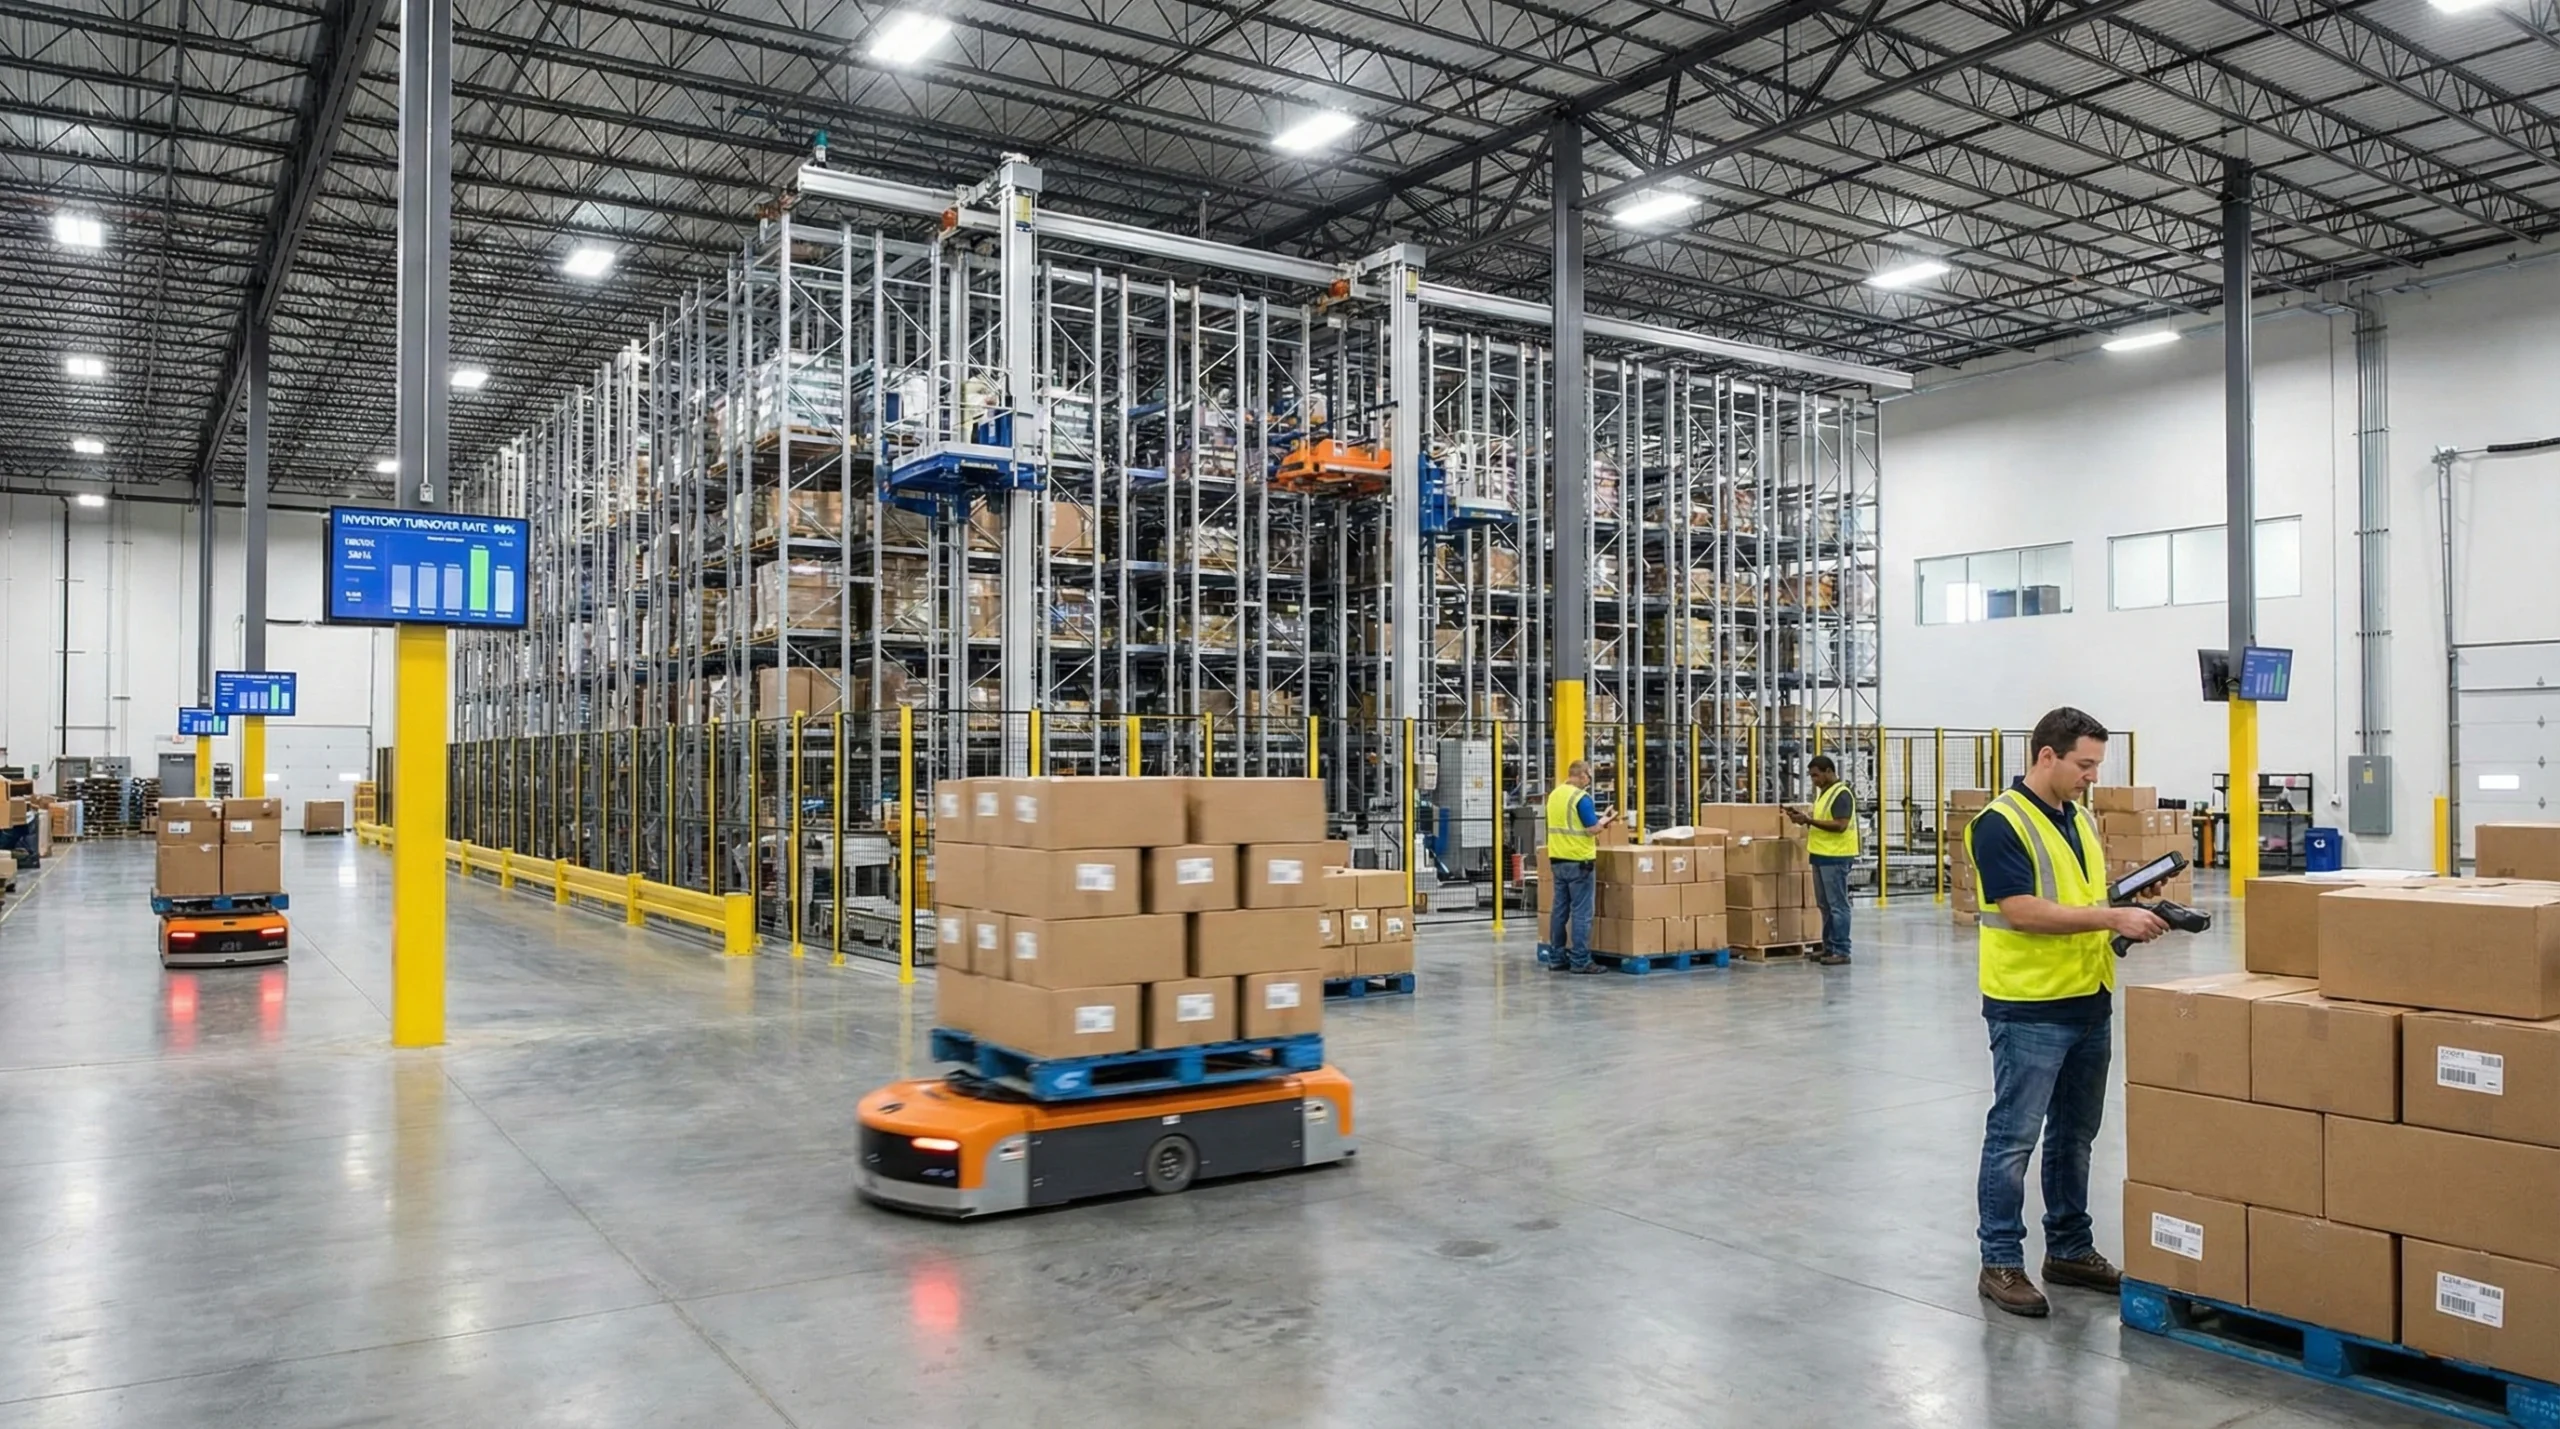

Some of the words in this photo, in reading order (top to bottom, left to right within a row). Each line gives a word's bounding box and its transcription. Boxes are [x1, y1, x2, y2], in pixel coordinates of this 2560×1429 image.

[342, 514, 402, 527] INVENTORY
[403, 517, 460, 531] TURNOVER
[461, 521, 488, 533] RATE
